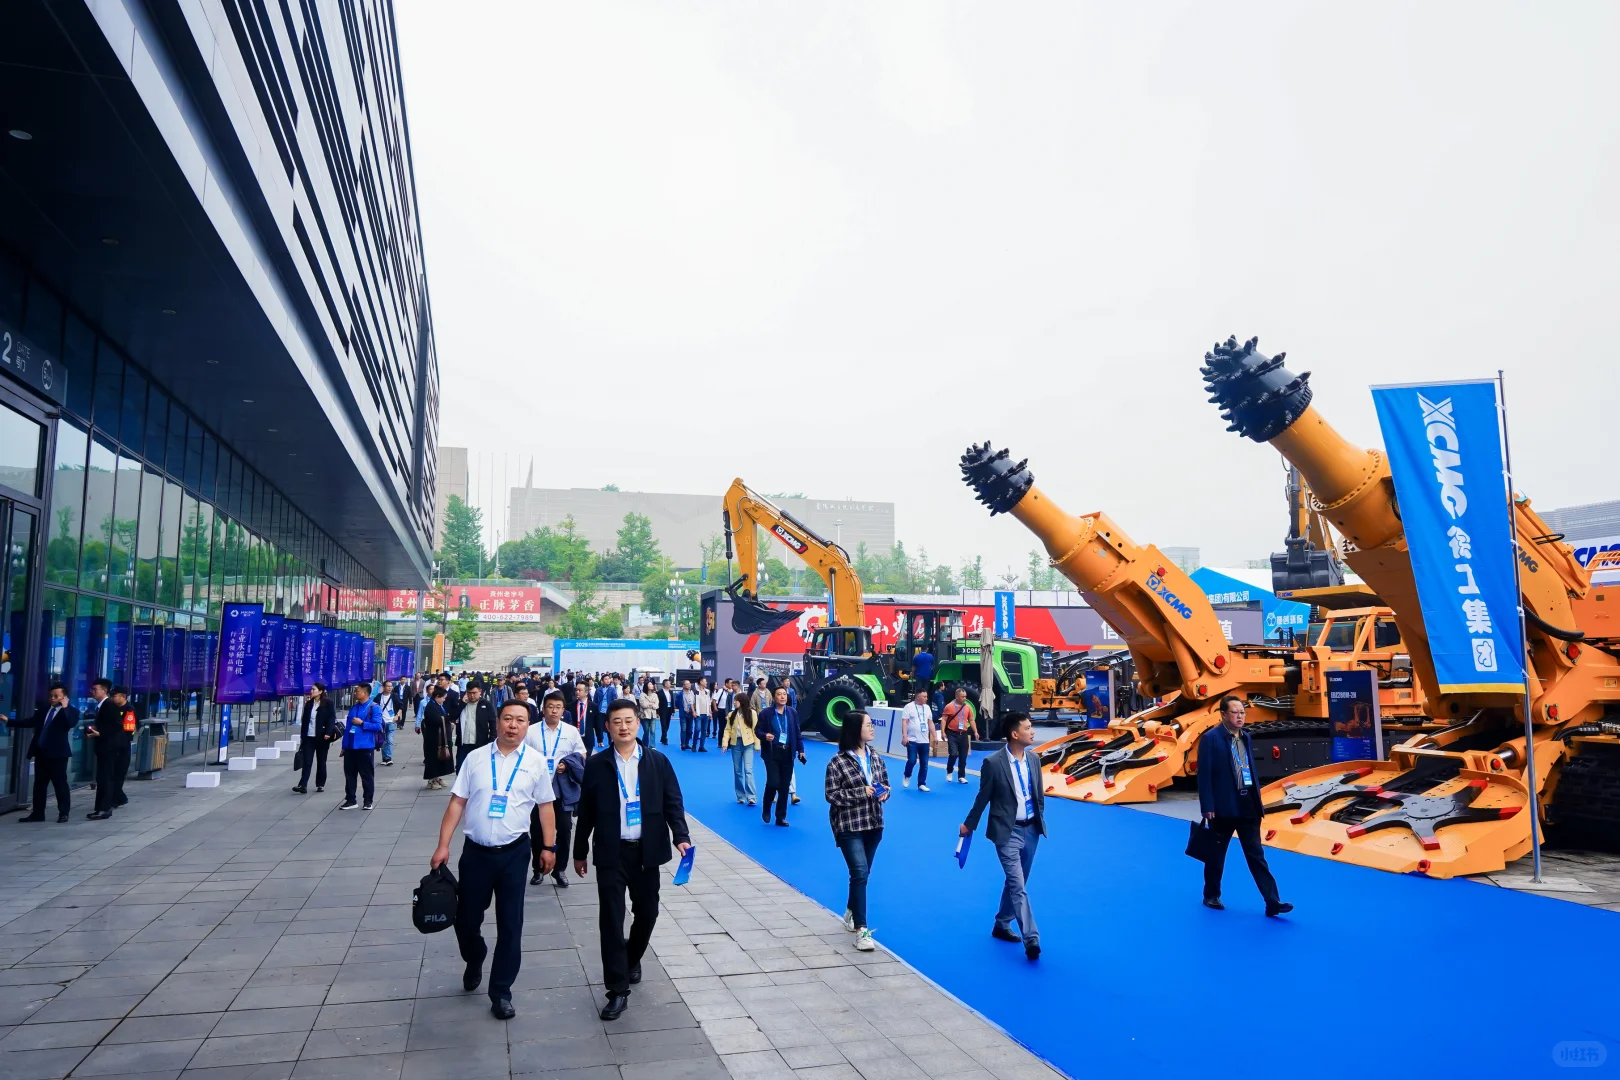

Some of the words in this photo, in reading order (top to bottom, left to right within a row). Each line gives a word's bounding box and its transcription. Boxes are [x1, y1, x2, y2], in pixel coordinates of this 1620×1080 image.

[2, 331, 12, 364] 2
[1416, 391, 1468, 520] XCMG
[783, 531, 802, 550] XCMG
[391, 596, 450, 609] 贵州国
[479, 598, 535, 612] 正脉茅香
[1001, 593, 1009, 630] XCMG
[1157, 586, 1193, 619] XCMG
[424, 914, 447, 923] FILA
